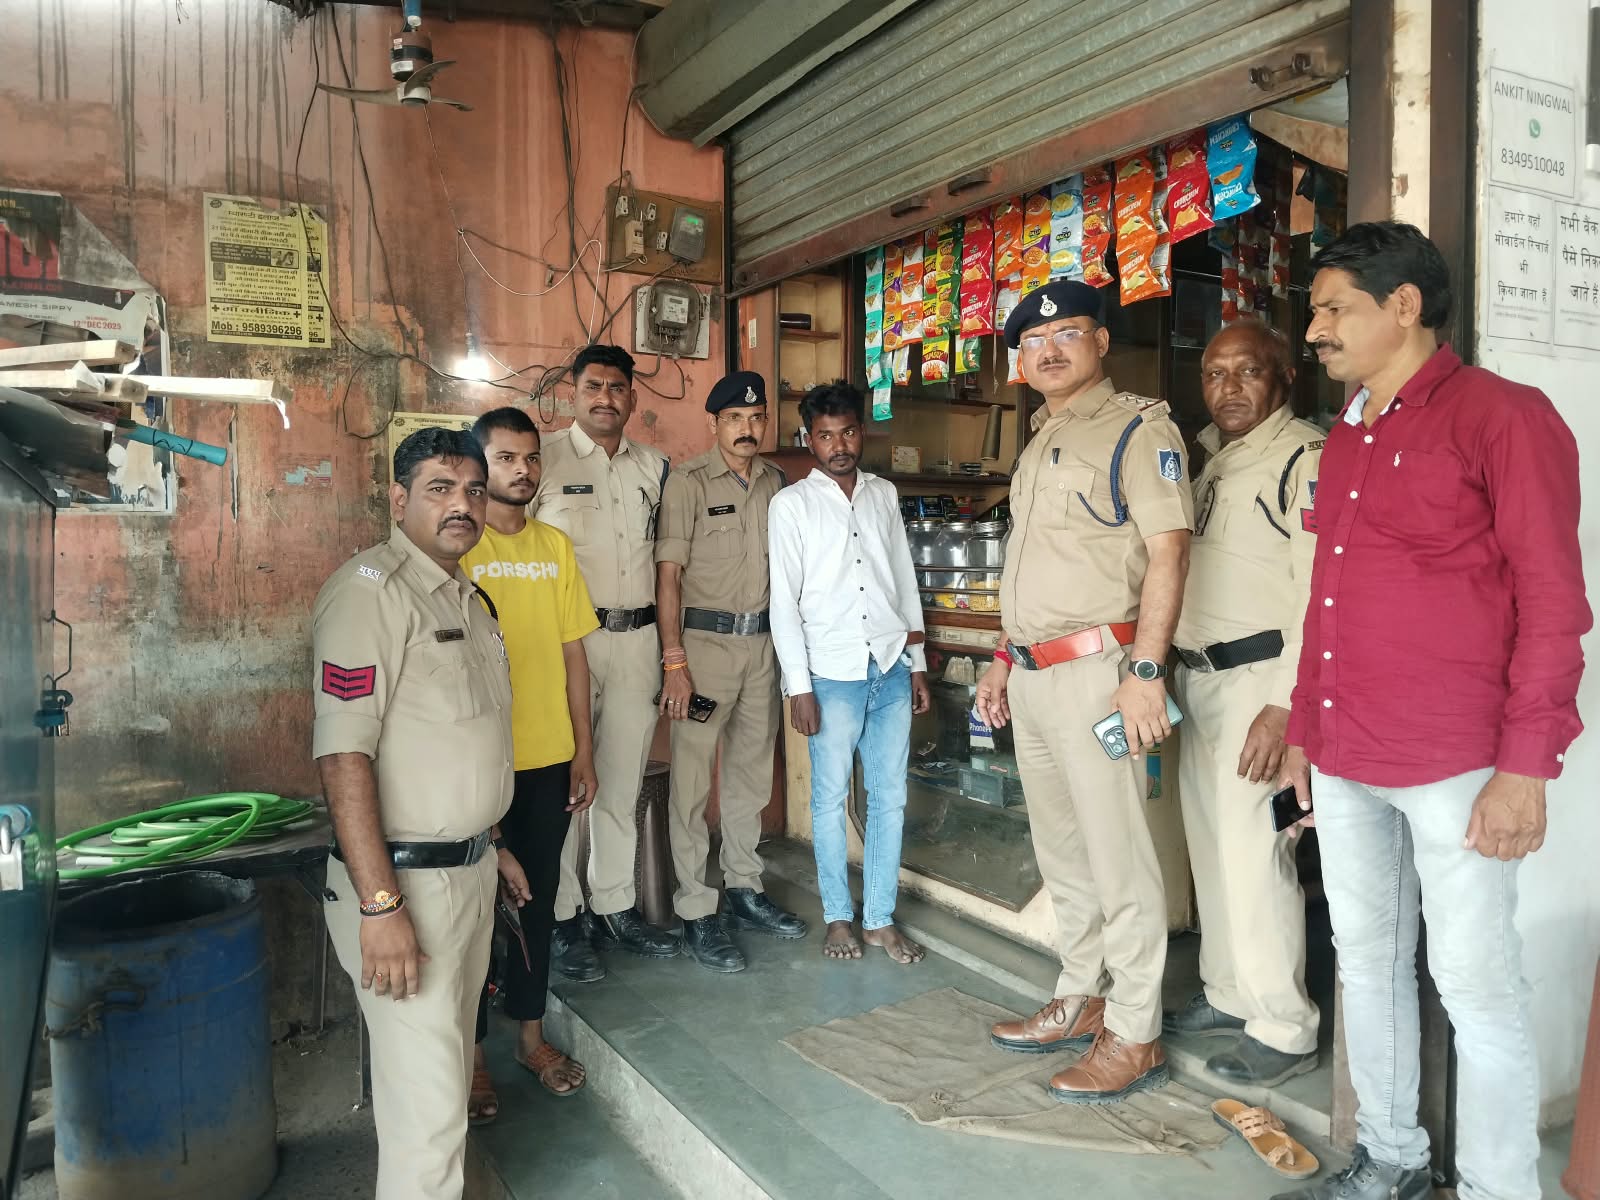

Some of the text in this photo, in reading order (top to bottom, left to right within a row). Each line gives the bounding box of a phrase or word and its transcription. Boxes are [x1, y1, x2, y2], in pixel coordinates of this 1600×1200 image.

[1494, 81, 1573, 114] ANKIT NINGWAL
[1501, 147, 1565, 177] 8349510048
[1504, 209, 1525, 223] हमारे
[1560, 212, 1580, 232] सभी
[1519, 259, 1528, 275] भी
[1570, 281, 1590, 302] जाते
[102, 321, 121, 329] 2025
[211, 320, 233, 331] Mob
[242, 322, 302, 336] 9589396296
